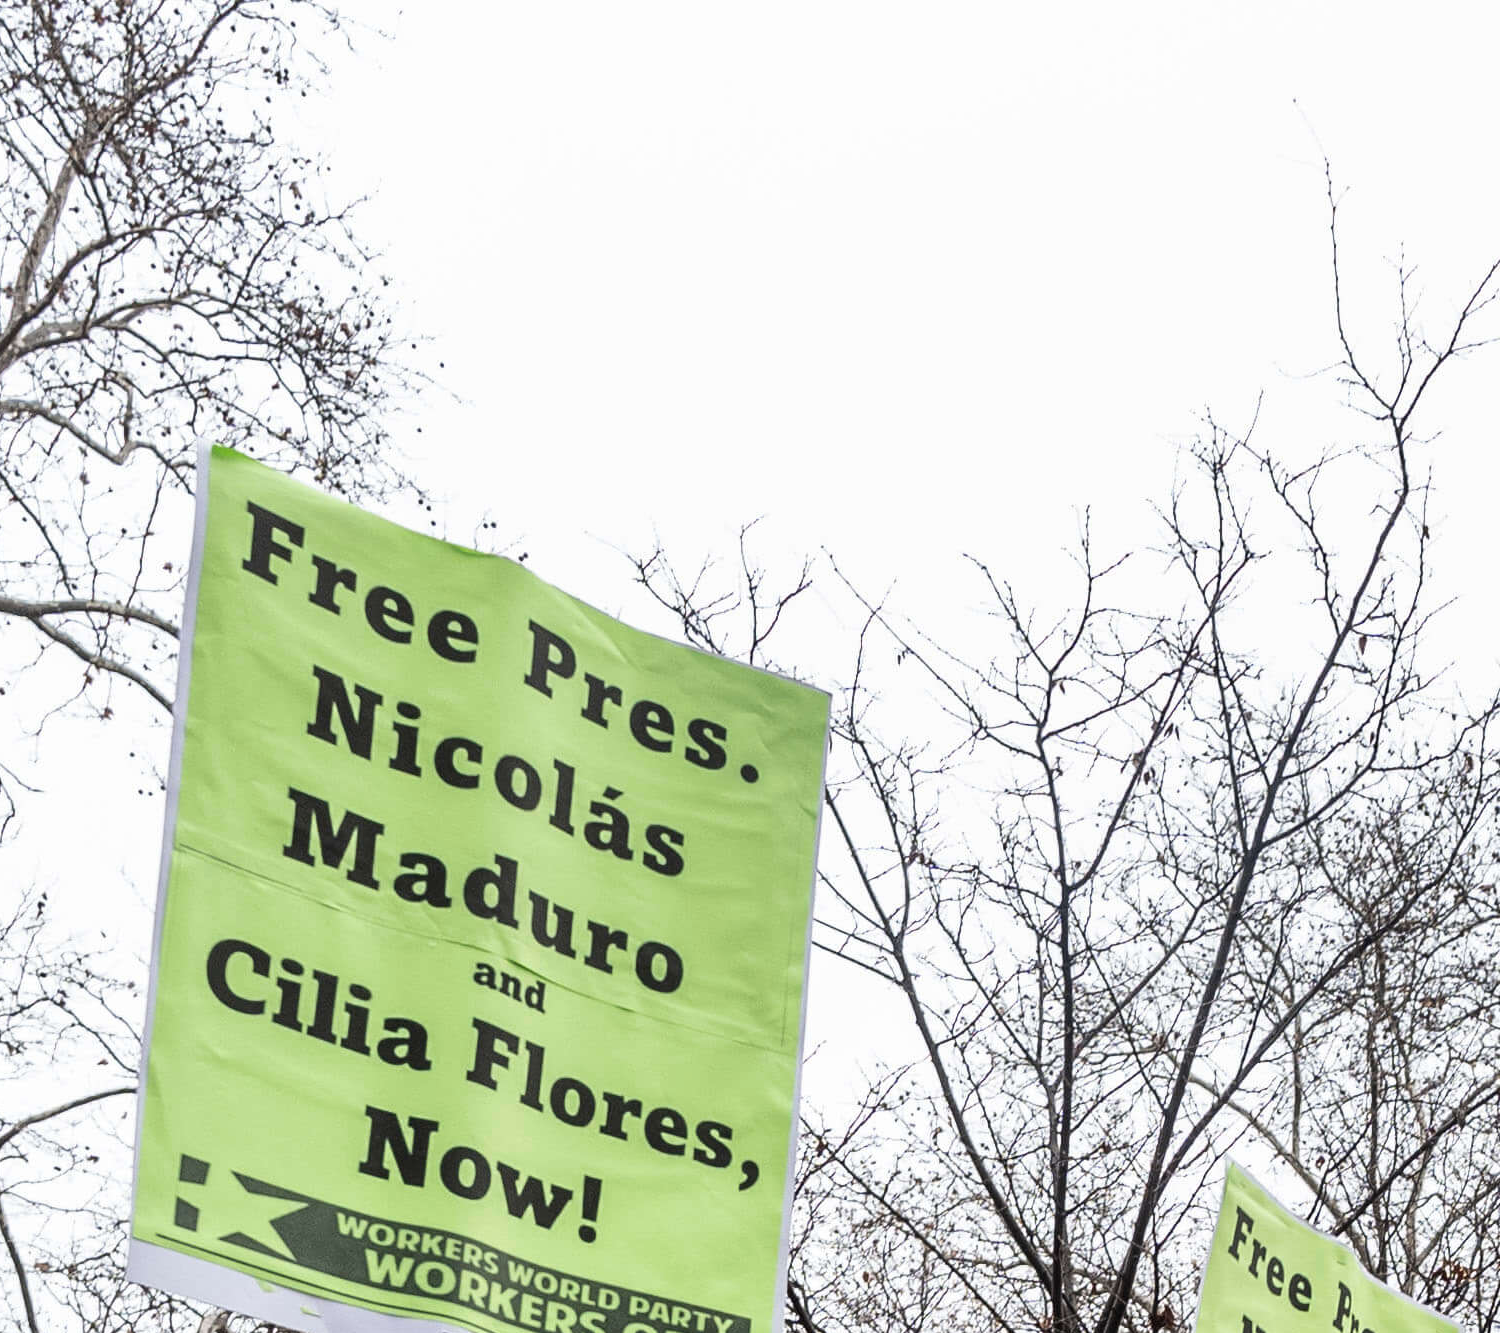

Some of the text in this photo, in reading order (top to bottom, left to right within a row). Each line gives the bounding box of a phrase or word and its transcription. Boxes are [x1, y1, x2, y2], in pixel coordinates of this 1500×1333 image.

[242, 501, 759, 784] Free Pres.
[306, 665, 685, 877] Nicolás
[282, 787, 684, 994] Maduro
[206, 939, 760, 1191] Cilia Flores,
[473, 962, 546, 1014] and
[336, 1211, 498, 1273] WORKERS
[508, 1260, 620, 1311] WORLD
[358, 1105, 602, 1244] Now!
[1228, 1206, 1312, 1312] Free
